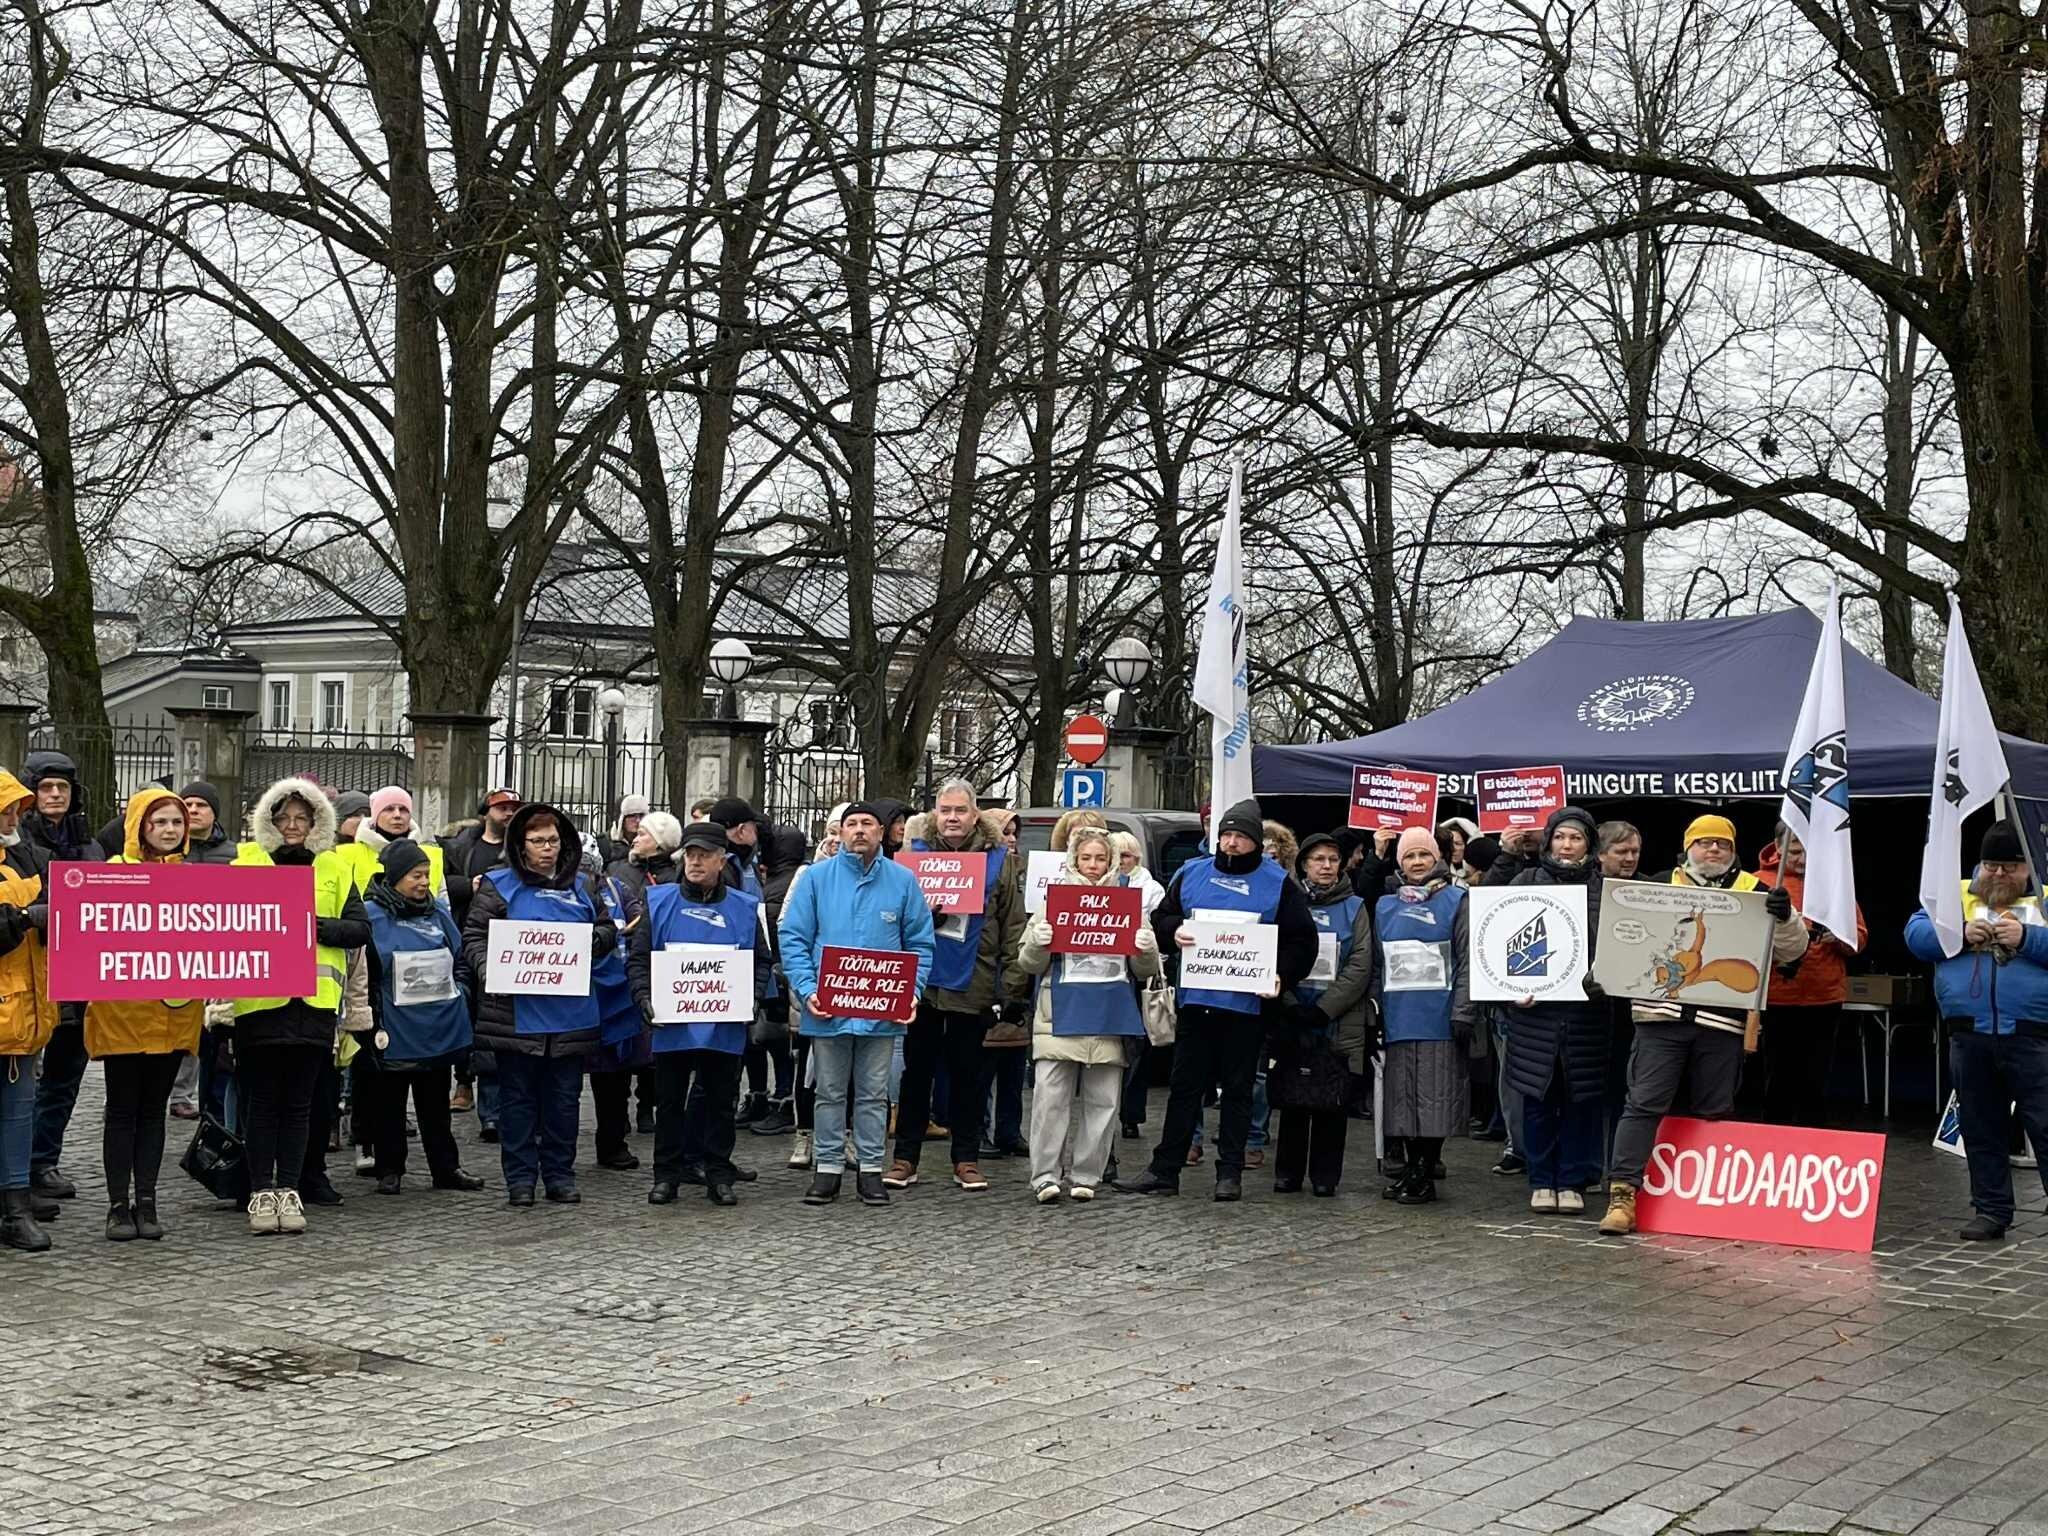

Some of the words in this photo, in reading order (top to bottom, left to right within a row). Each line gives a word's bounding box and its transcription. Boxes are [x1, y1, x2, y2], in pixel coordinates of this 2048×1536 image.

[1359, 773, 1371, 785] Ei
[1371, 774, 1430, 793] töölepingu
[1438, 774, 1478, 794] ESTI
[1566, 773, 1663, 795] HINGUTE
[1675, 770, 1779, 794] KESKLIIT
[1483, 777, 1495, 790] Ei
[1495, 775, 1557, 789] töölepingu
[1072, 775, 1094, 808] P
[1369, 787, 1417, 801] seaduse
[1496, 787, 1545, 800] seaduse
[1358, 797, 1427, 813] muutmisele!
[1486, 796, 1557, 811] muutmisele!
[918, 857, 961, 873] TÖÖAEG
[919, 876, 943, 889] TOHI
[945, 876, 974, 889] OLLA
[1079, 894, 1110, 908] PALK
[80, 902, 152, 932] PETAD
[158, 903, 288, 935] BUSSIJUHTI,
[1056, 911, 1070, 925] EI
[1073, 912, 1099, 927] TOHI
[1101, 914, 1130, 928] OLLA
[1499, 895, 1530, 909] STRONG
[1531, 895, 1555, 908] UNION
[1559, 908, 1579, 938] STRONG
[518, 928, 566, 946] TÖÖAEG
[1070, 931, 1116, 946] LOTERII
[1506, 915, 1547, 955] EMSA
[99, 951, 172, 981] PETAD
[177, 950, 270, 980] VALIJAT!
[500, 950, 514, 964] EI
[518, 951, 545, 965] TOHI
[548, 952, 579, 967] OLLA
[838, 954, 904, 975] TÖÖTAJATE
[681, 960, 727, 974] VAJAME
[1185, 963, 1223, 975] ROHKEM
[514, 970, 564, 985] LOTERII
[824, 973, 872, 991] TULEVIK
[874, 979, 908, 993] POLE
[1499, 980, 1530, 994] STRONG
[1531, 983, 1555, 994] UNION
[676, 999, 731, 1013] DIALOOGI
